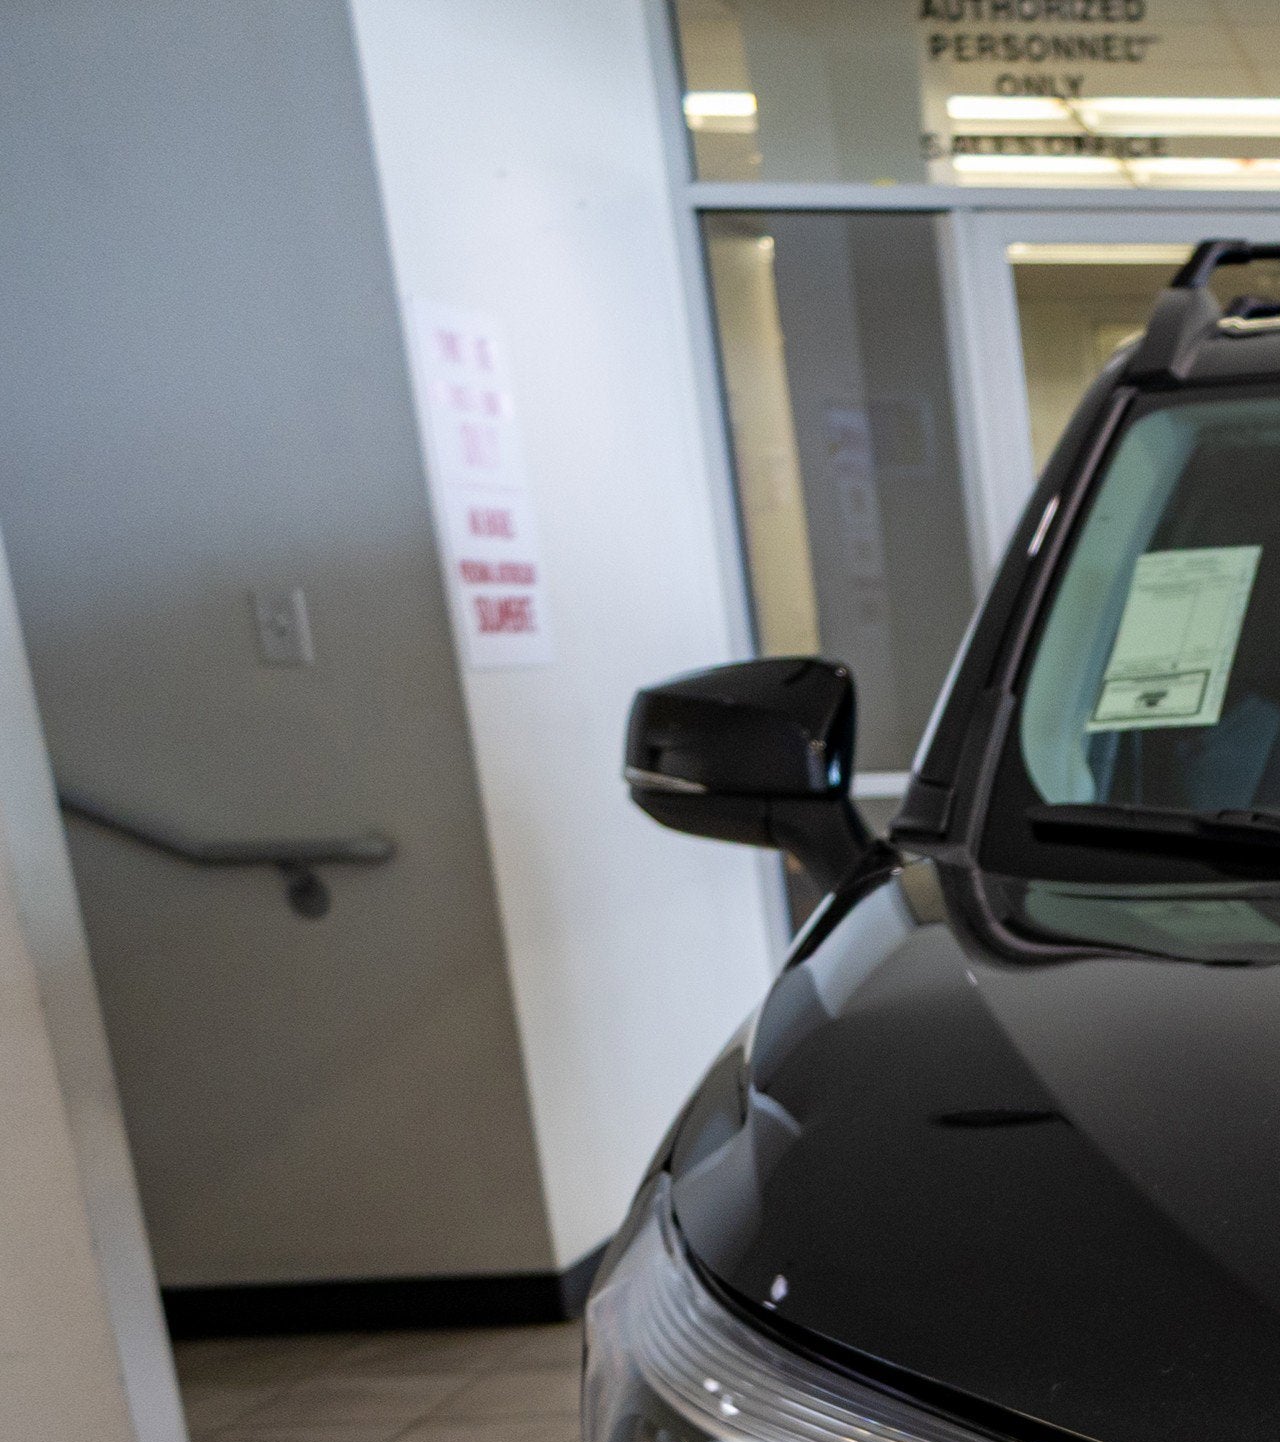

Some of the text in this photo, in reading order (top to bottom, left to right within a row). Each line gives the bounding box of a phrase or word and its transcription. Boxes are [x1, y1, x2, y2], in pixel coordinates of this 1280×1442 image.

[919, 0, 1146, 21] AUTHORIZED
[928, 33, 1146, 62] PERSONNEL
[995, 73, 1084, 97] ONLY
